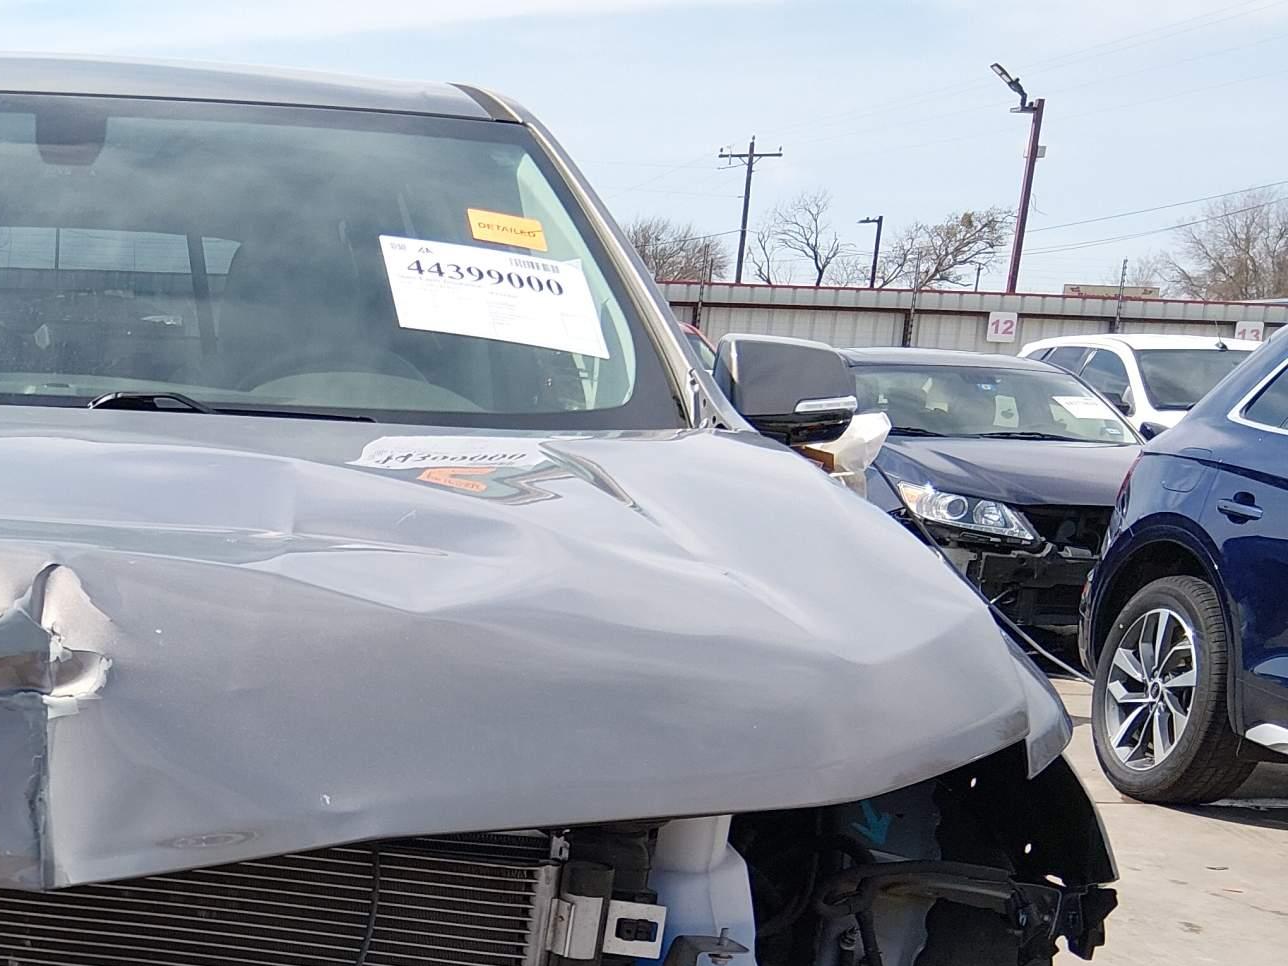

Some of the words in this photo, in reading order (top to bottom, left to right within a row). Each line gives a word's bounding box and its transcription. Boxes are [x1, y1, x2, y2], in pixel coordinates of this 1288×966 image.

[407, 259, 564, 296] 44399000
[991, 319, 1015, 335] 12
[1238, 328, 1261, 341] 13
